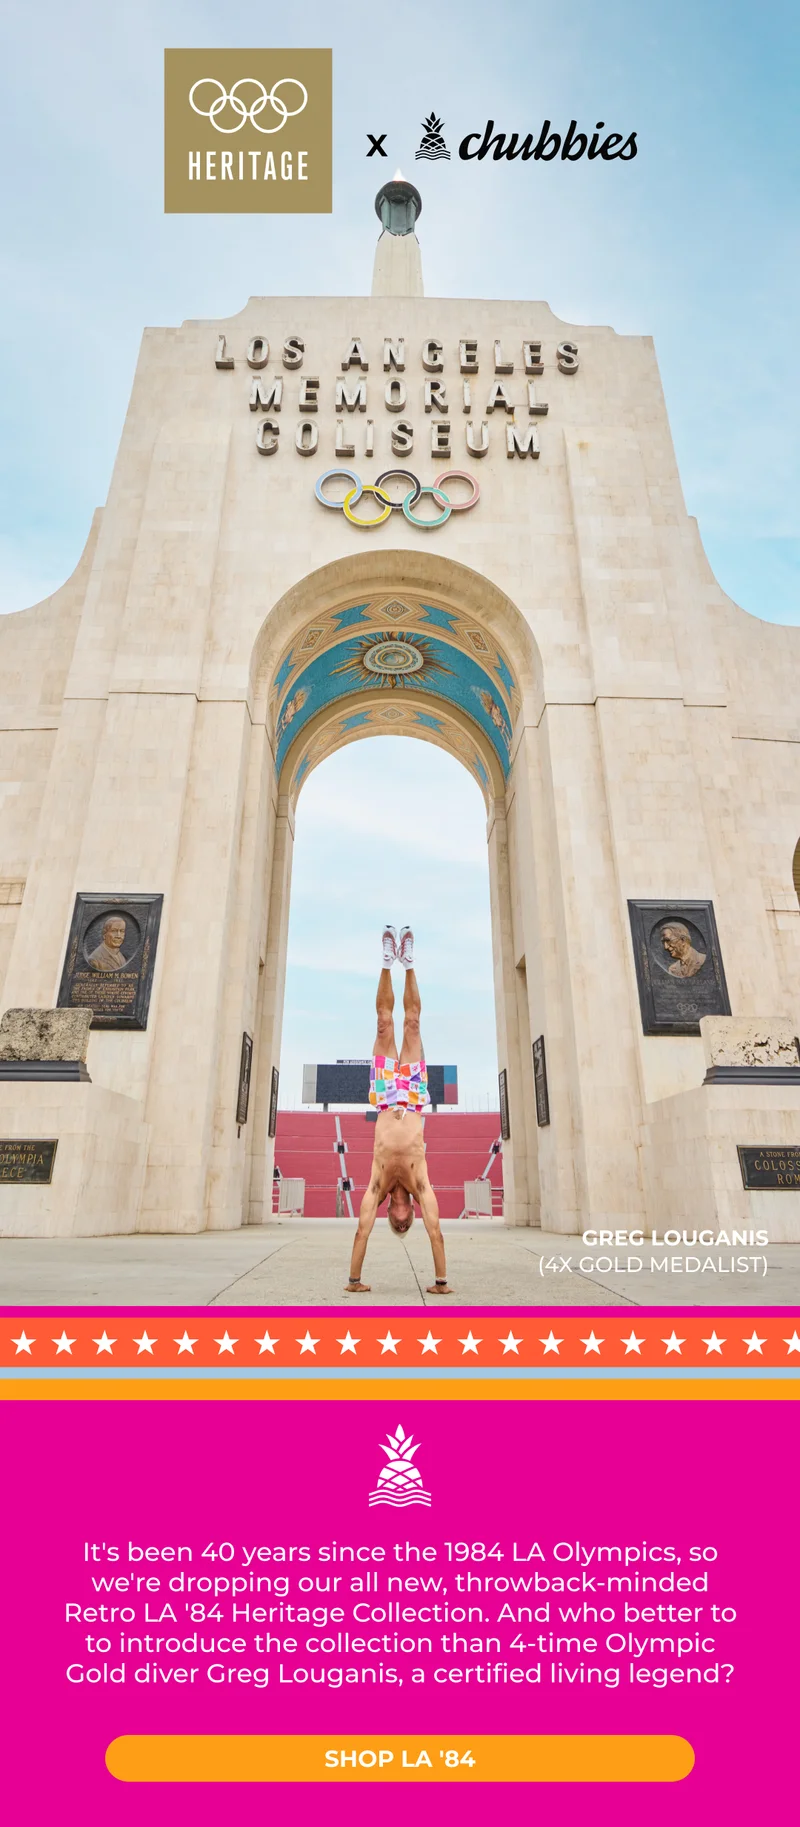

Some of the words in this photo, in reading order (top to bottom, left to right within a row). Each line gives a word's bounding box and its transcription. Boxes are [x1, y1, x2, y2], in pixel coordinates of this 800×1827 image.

[214, 334, 305, 370] LOS
[341, 337, 580, 375] ANGELES
[249, 375, 549, 415] MEMORIAL
[255, 417, 541, 459] COLISEUM
